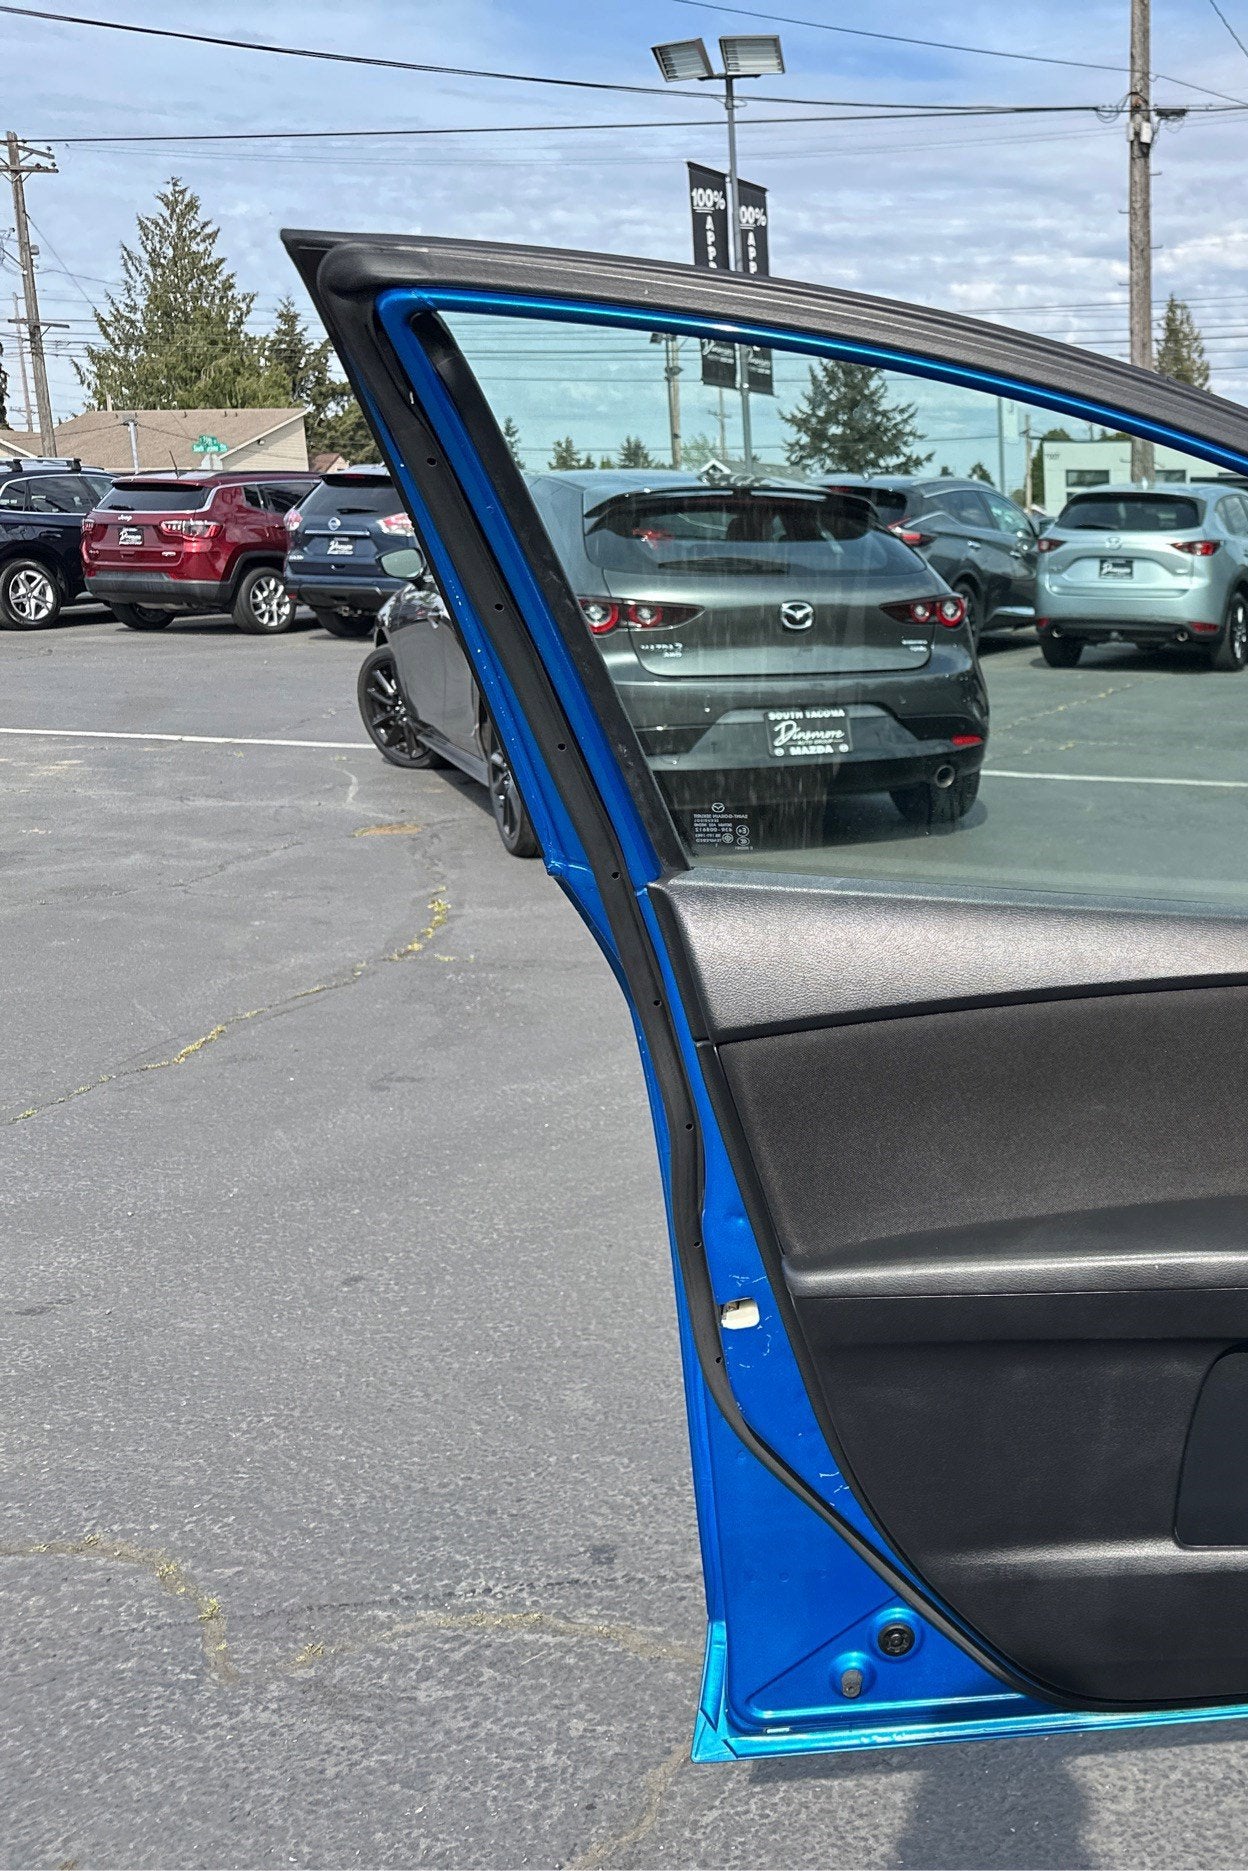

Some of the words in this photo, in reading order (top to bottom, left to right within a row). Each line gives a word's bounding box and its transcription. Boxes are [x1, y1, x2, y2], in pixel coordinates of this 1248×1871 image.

[691, 187, 726, 211] 100%
[739, 205, 767, 227] 00%
[768, 711, 804, 721] SOUTH
[805, 709, 846, 719] TACOMA
[773, 720, 845, 747] Dinsmore
[789, 745, 834, 755] MAZDA
